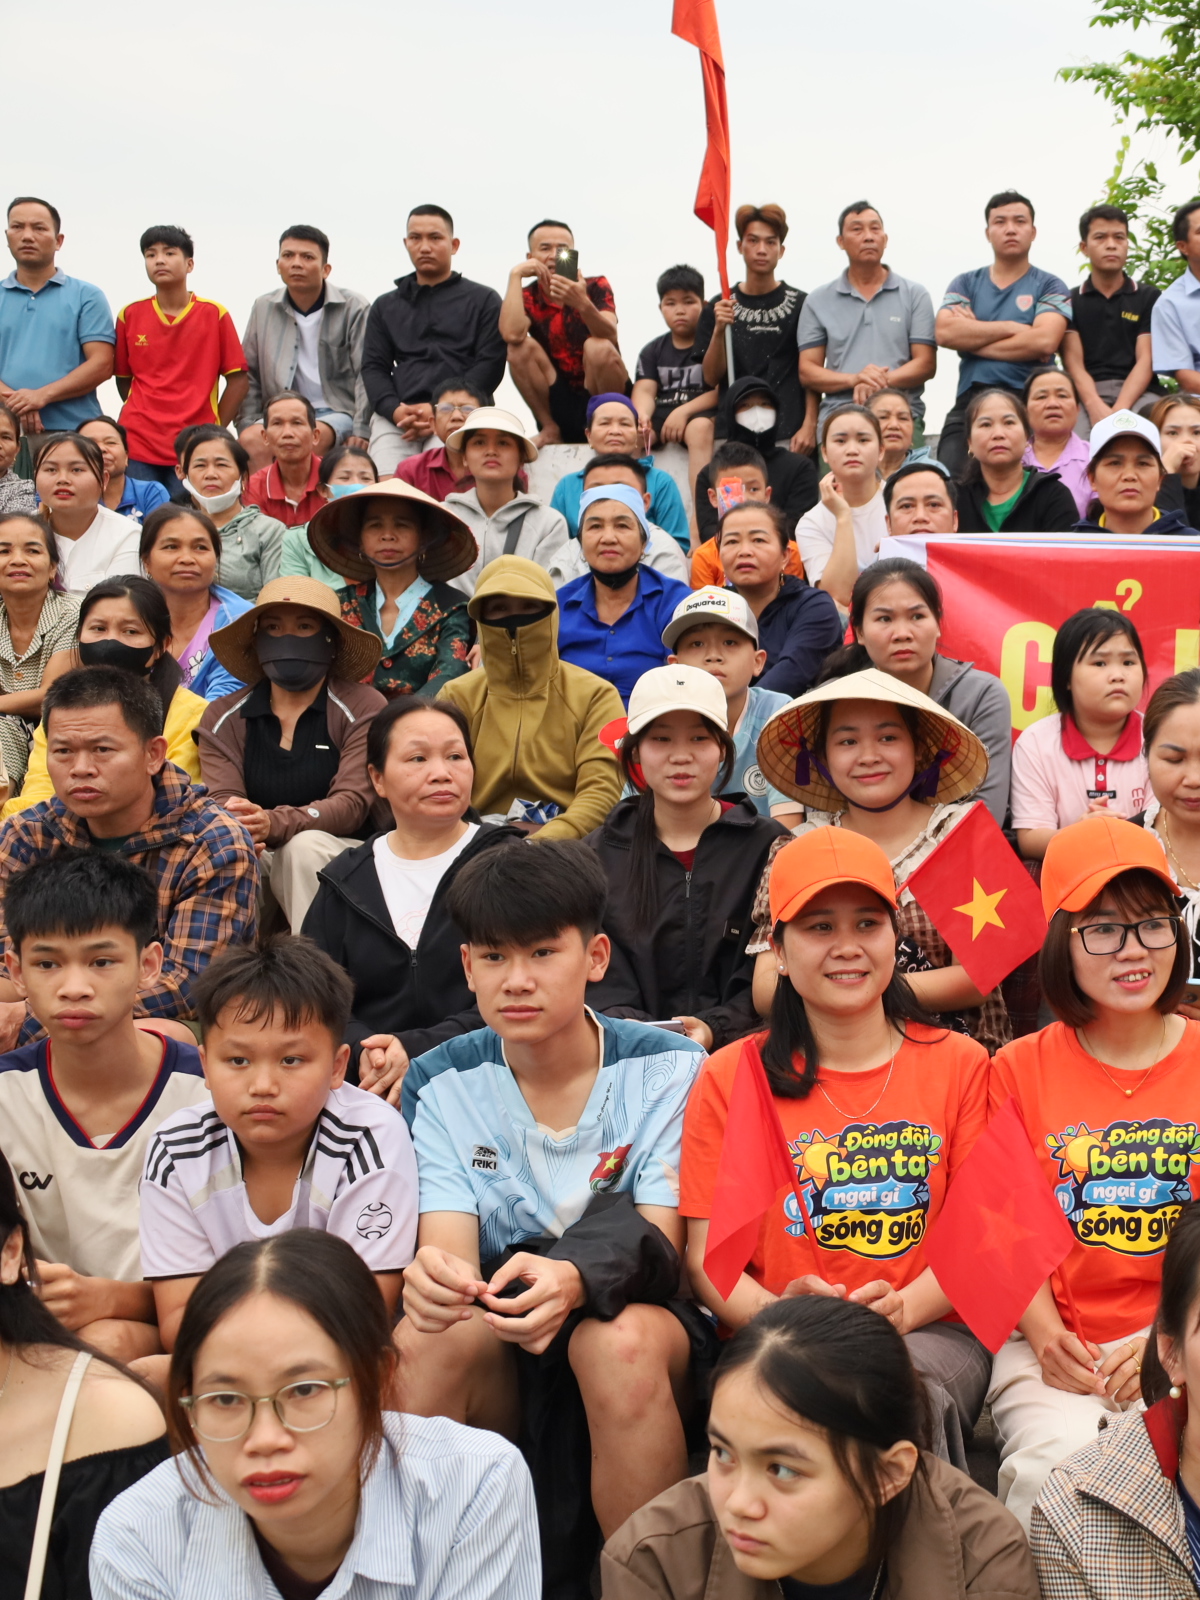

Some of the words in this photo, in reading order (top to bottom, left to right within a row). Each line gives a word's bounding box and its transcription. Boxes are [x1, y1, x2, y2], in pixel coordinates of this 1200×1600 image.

[844, 1126, 898, 1151] Đồng
[900, 1125, 930, 1150] đội
[1107, 1123, 1160, 1147] Đồng
[1162, 1125, 1196, 1148] đội
[472, 1159, 497, 1170] RIKI
[829, 1154, 888, 1183] bên
[891, 1149, 926, 1177] ta
[1090, 1147, 1148, 1176] bên
[1151, 1146, 1188, 1176] ta
[833, 1186, 877, 1207] ngại
[880, 1184, 904, 1206] gì
[1093, 1182, 1136, 1203] ngại
[1138, 1181, 1162, 1204] gì
[820, 1215, 883, 1245] sóng
[888, 1212, 923, 1246] gió
[1080, 1210, 1142, 1242] sóng
